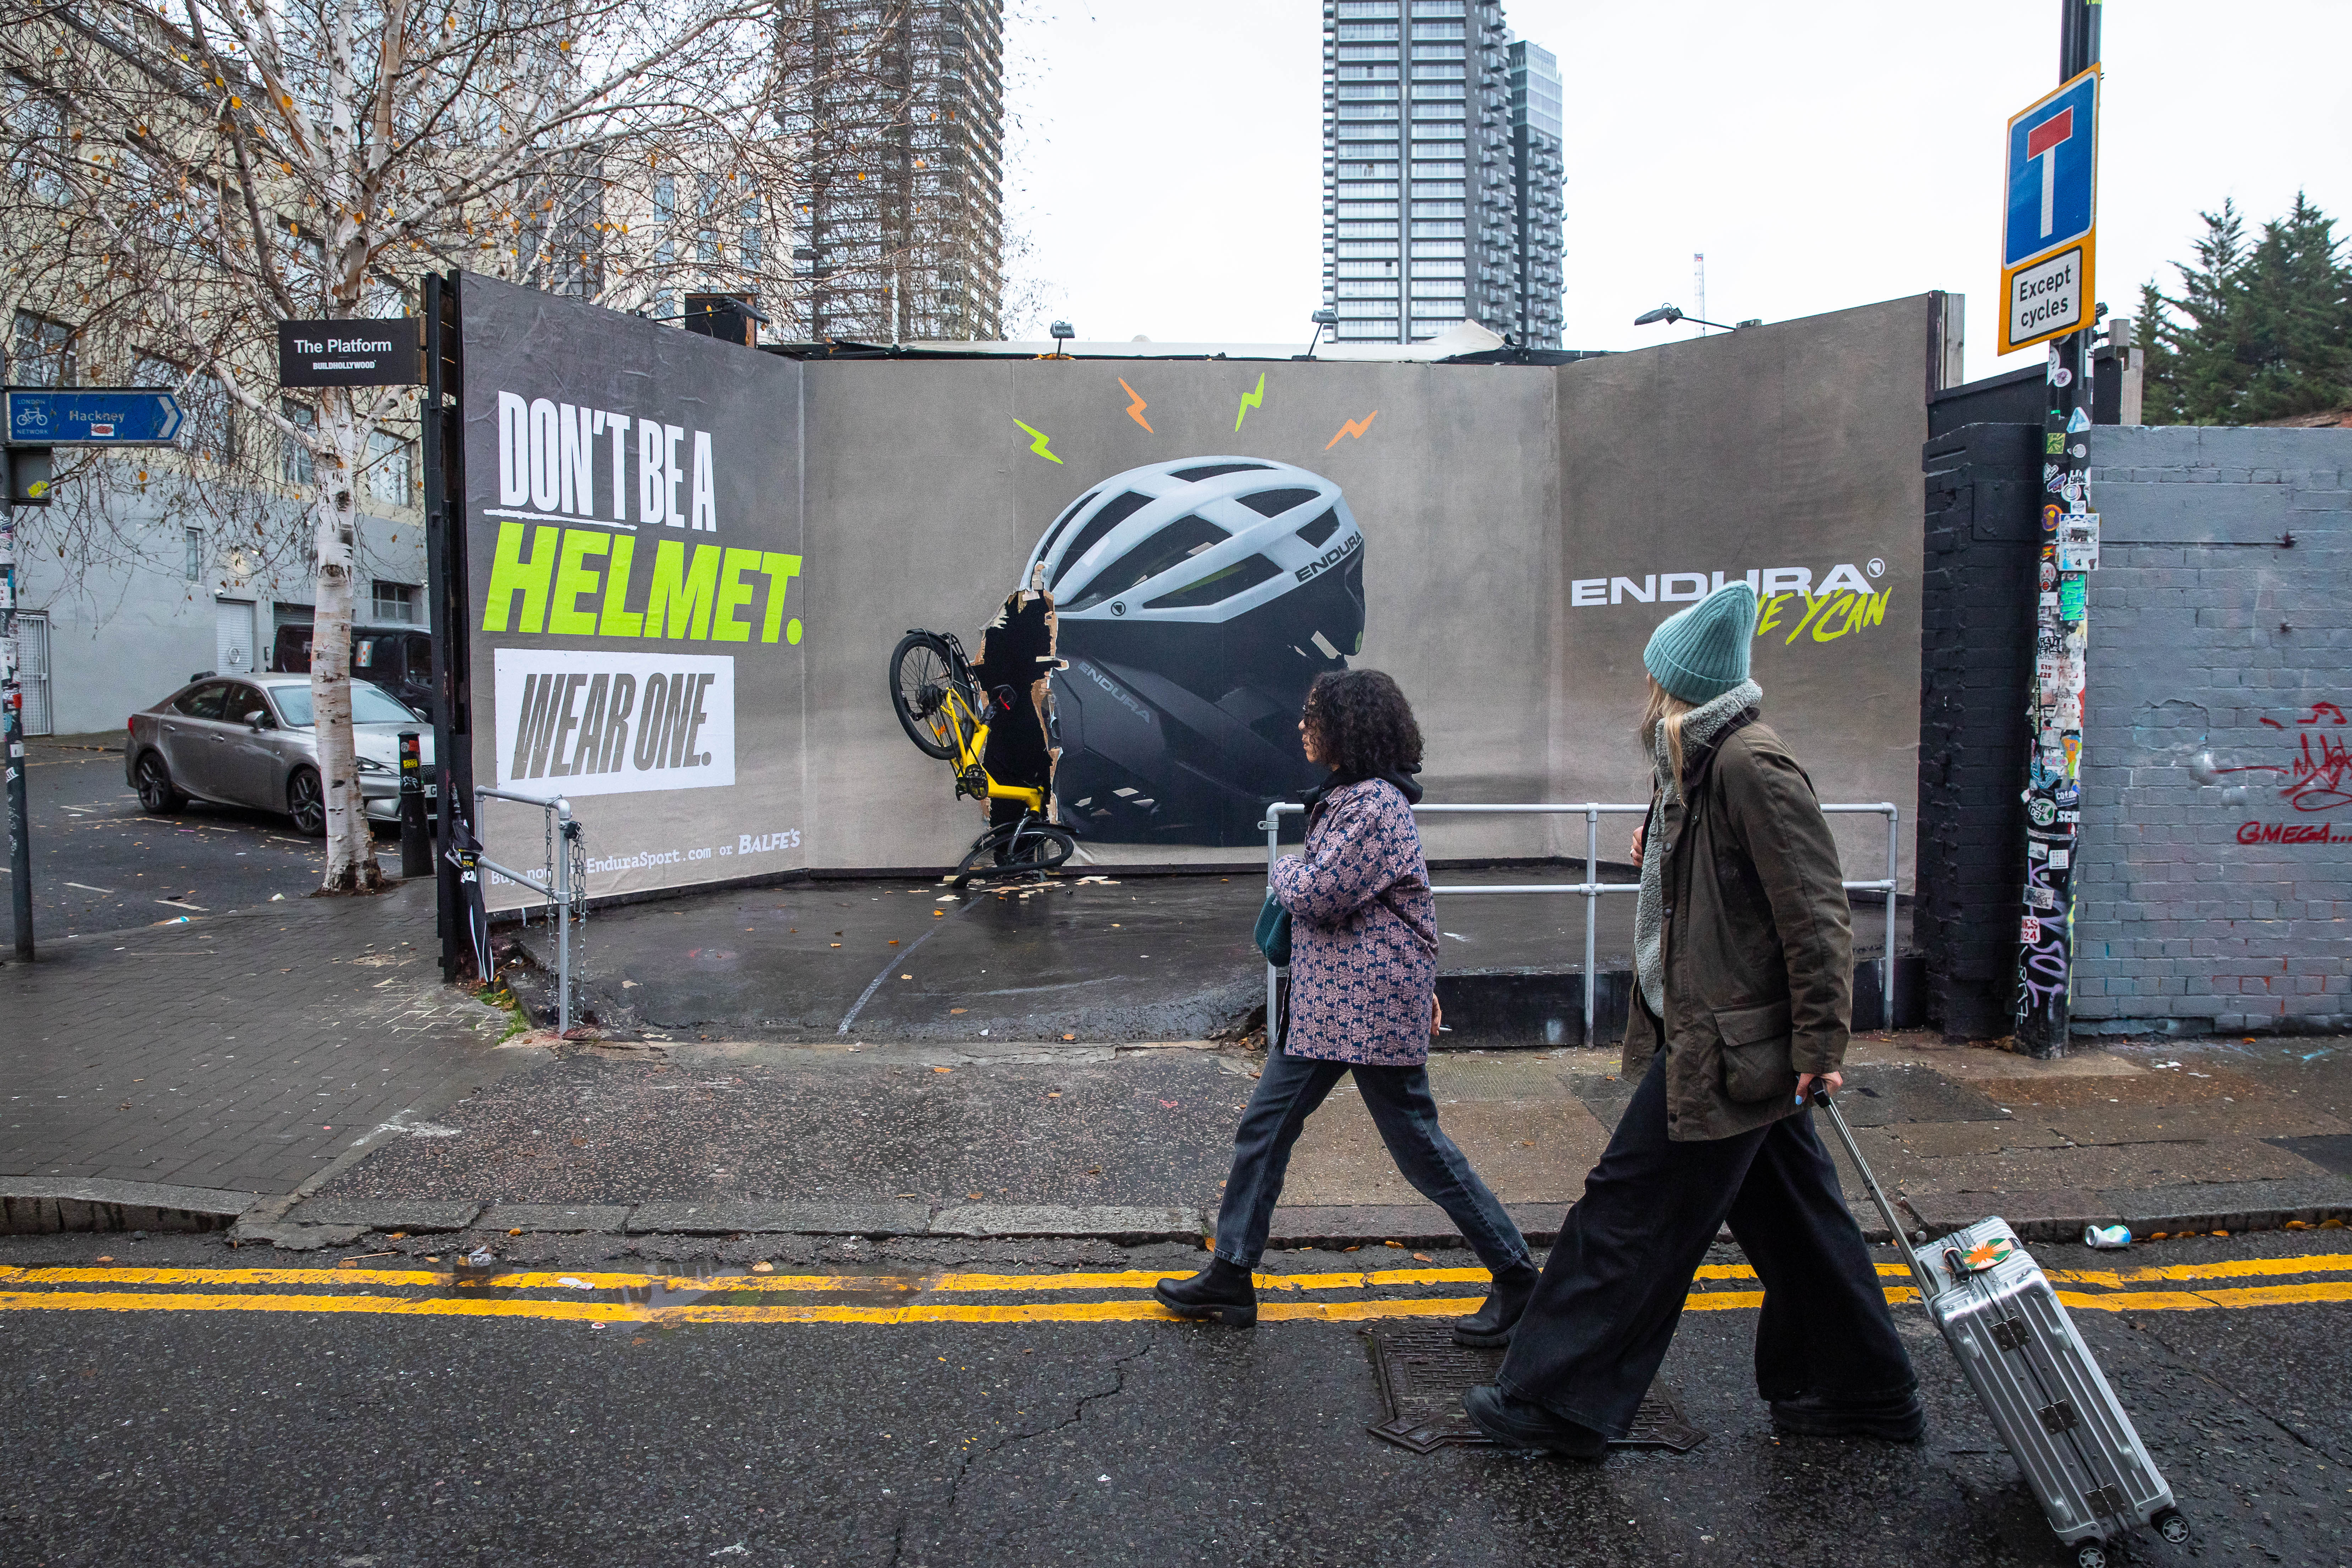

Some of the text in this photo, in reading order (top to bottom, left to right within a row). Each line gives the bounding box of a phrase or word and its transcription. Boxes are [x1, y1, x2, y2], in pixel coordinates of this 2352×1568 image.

[2019, 264, 2071, 302] Except
[2021, 295, 2068, 328] cycles
[294, 338, 392, 353] The Platform
[313, 361, 375, 370] BUILDHOLLYWOOD
[69, 410, 125, 423] Hackney
[499, 390, 717, 532] DON'T BE A
[1295, 530, 1362, 583] ENDURA
[482, 521, 802, 645] HELMET.
[1077, 661, 1150, 724] ENDURA
[510, 672, 716, 780] WEAR ONE.
[586, 846, 712, 874] EnduraSport.com
[719, 845, 733, 856] or
[738, 828, 801, 855] BALFE'S
[2021, 931, 2037, 941] 24
